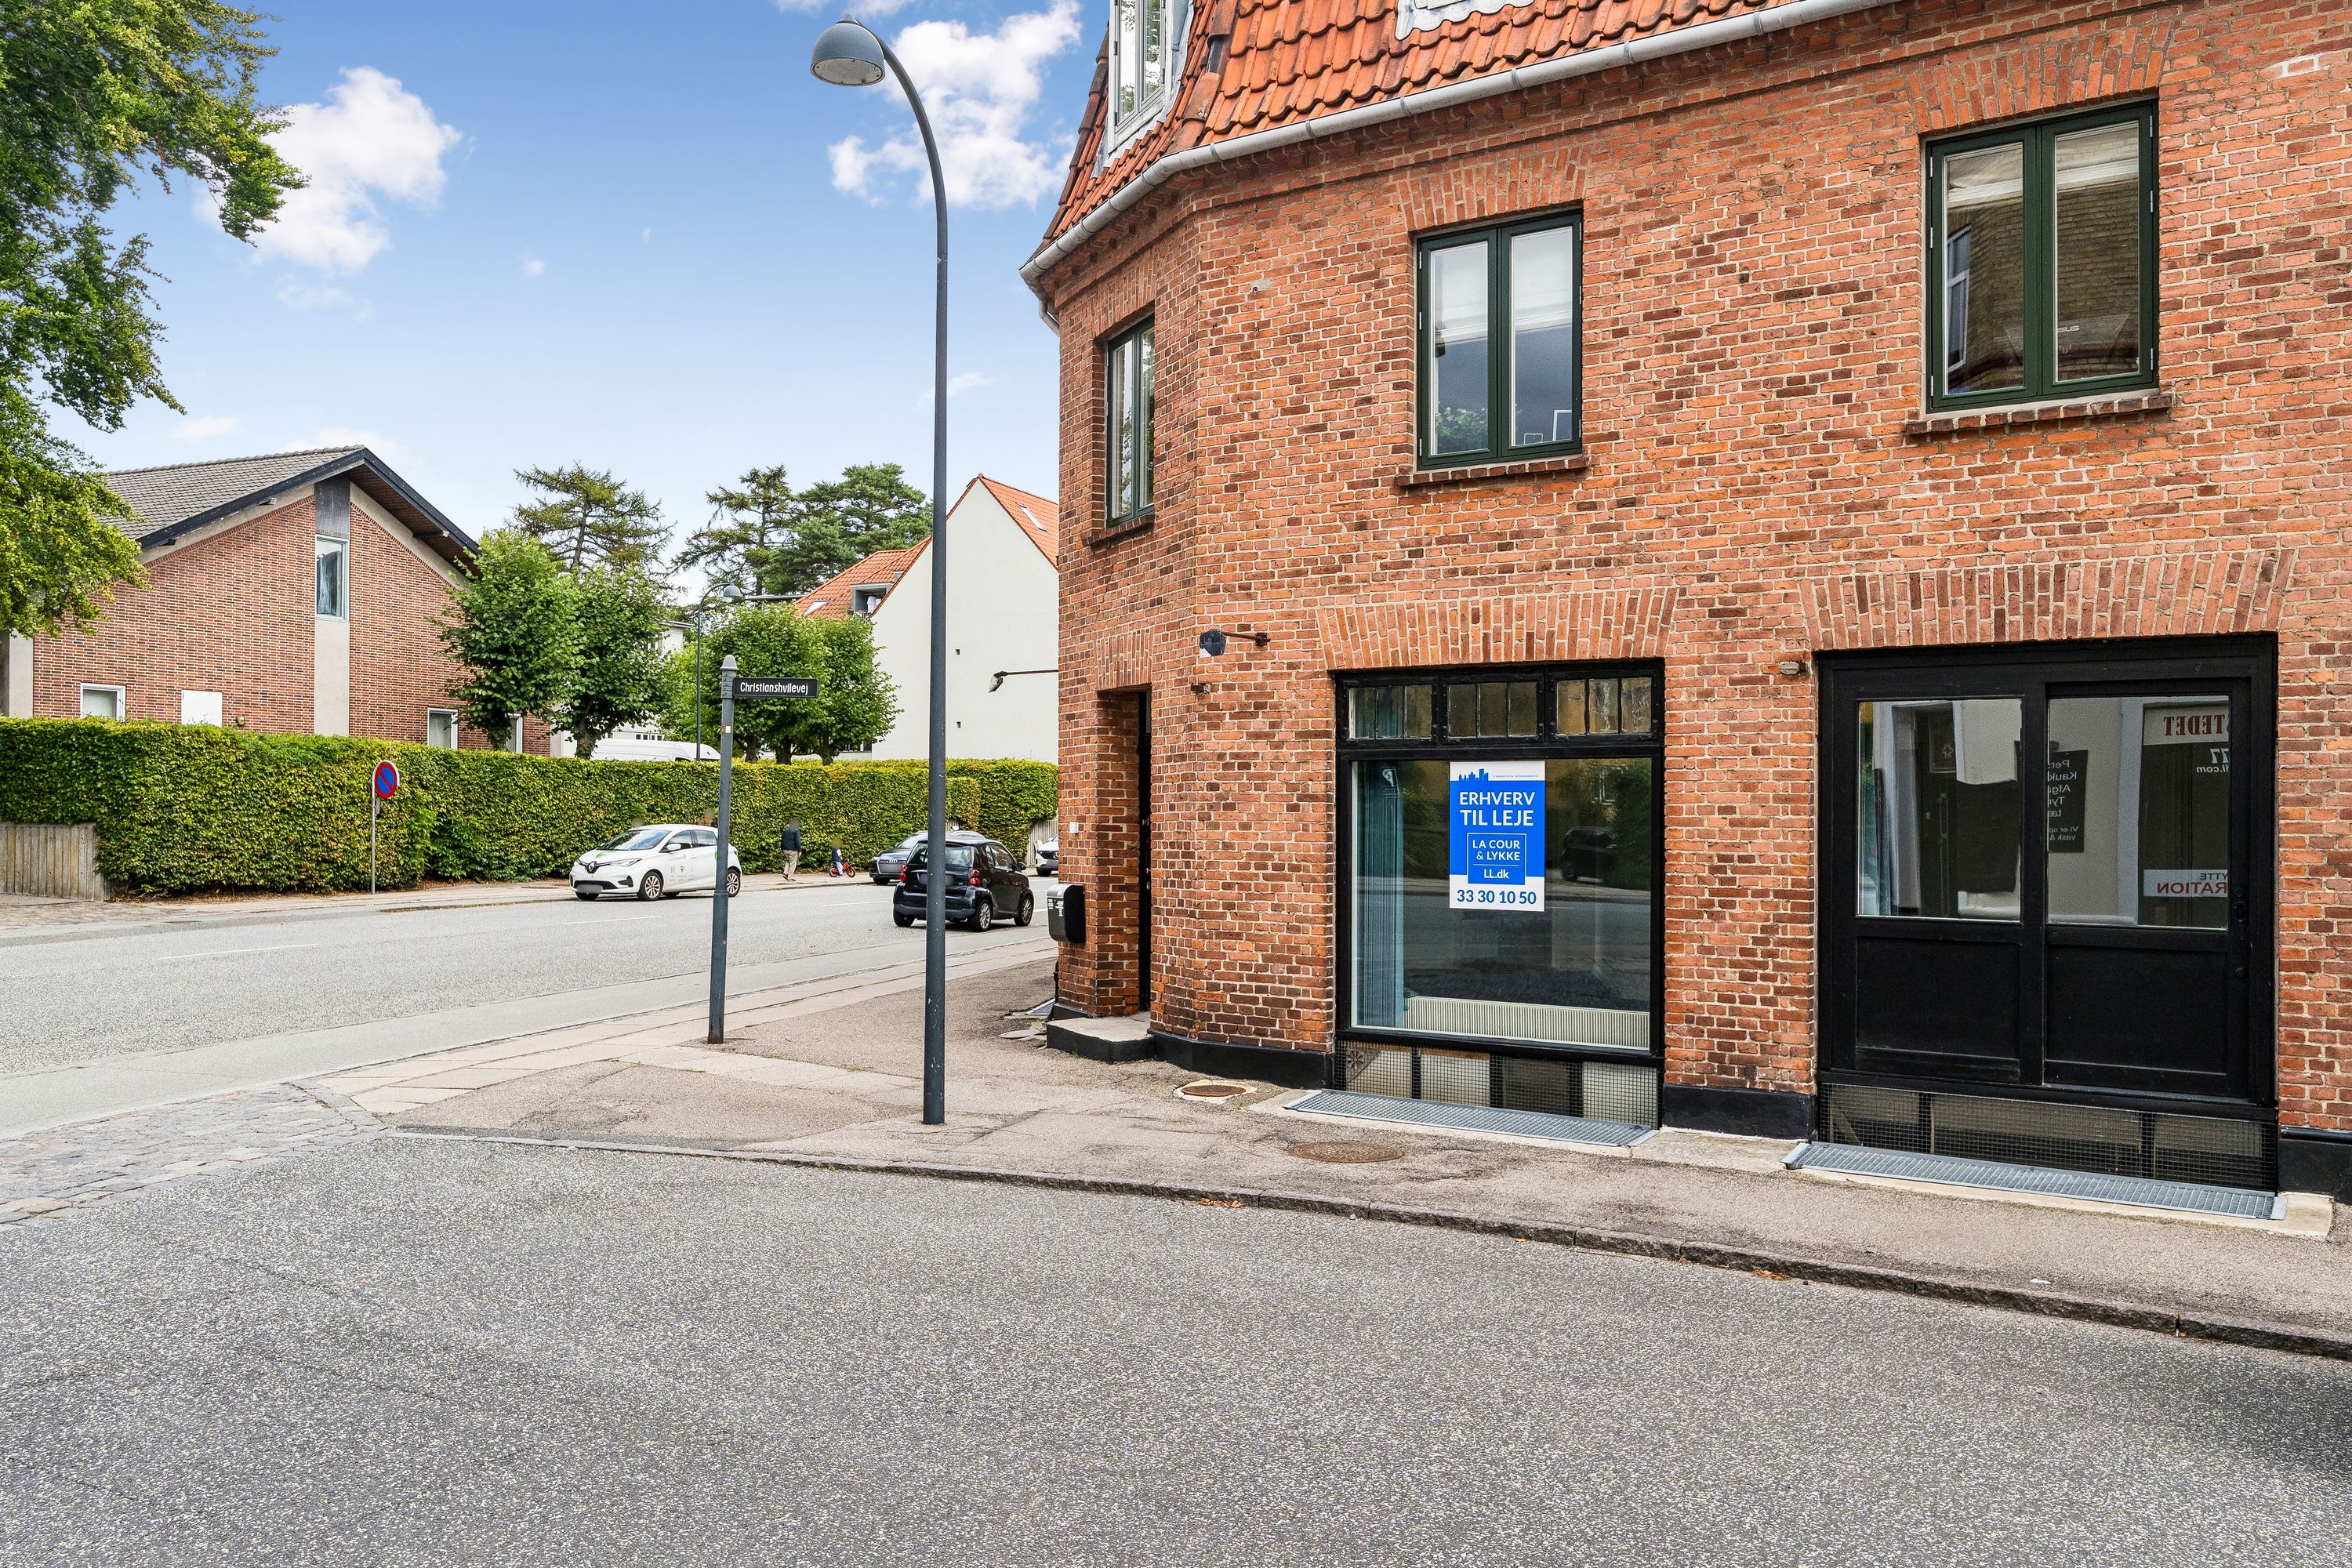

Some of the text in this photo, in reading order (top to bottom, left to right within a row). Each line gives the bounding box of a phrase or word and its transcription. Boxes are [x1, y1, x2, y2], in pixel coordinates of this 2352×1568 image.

[740, 681, 808, 695] Christianshvilevej
[1459, 791, 1535, 805] ERHVERV
[1460, 809, 1534, 826] TIL LEJE
[1472, 840, 1520, 849] LA COUR
[1476, 851, 1520, 861] & LYKKE
[1483, 869, 1509, 879] LL.dk
[1457, 889, 1537, 904] 33 30 10 50
